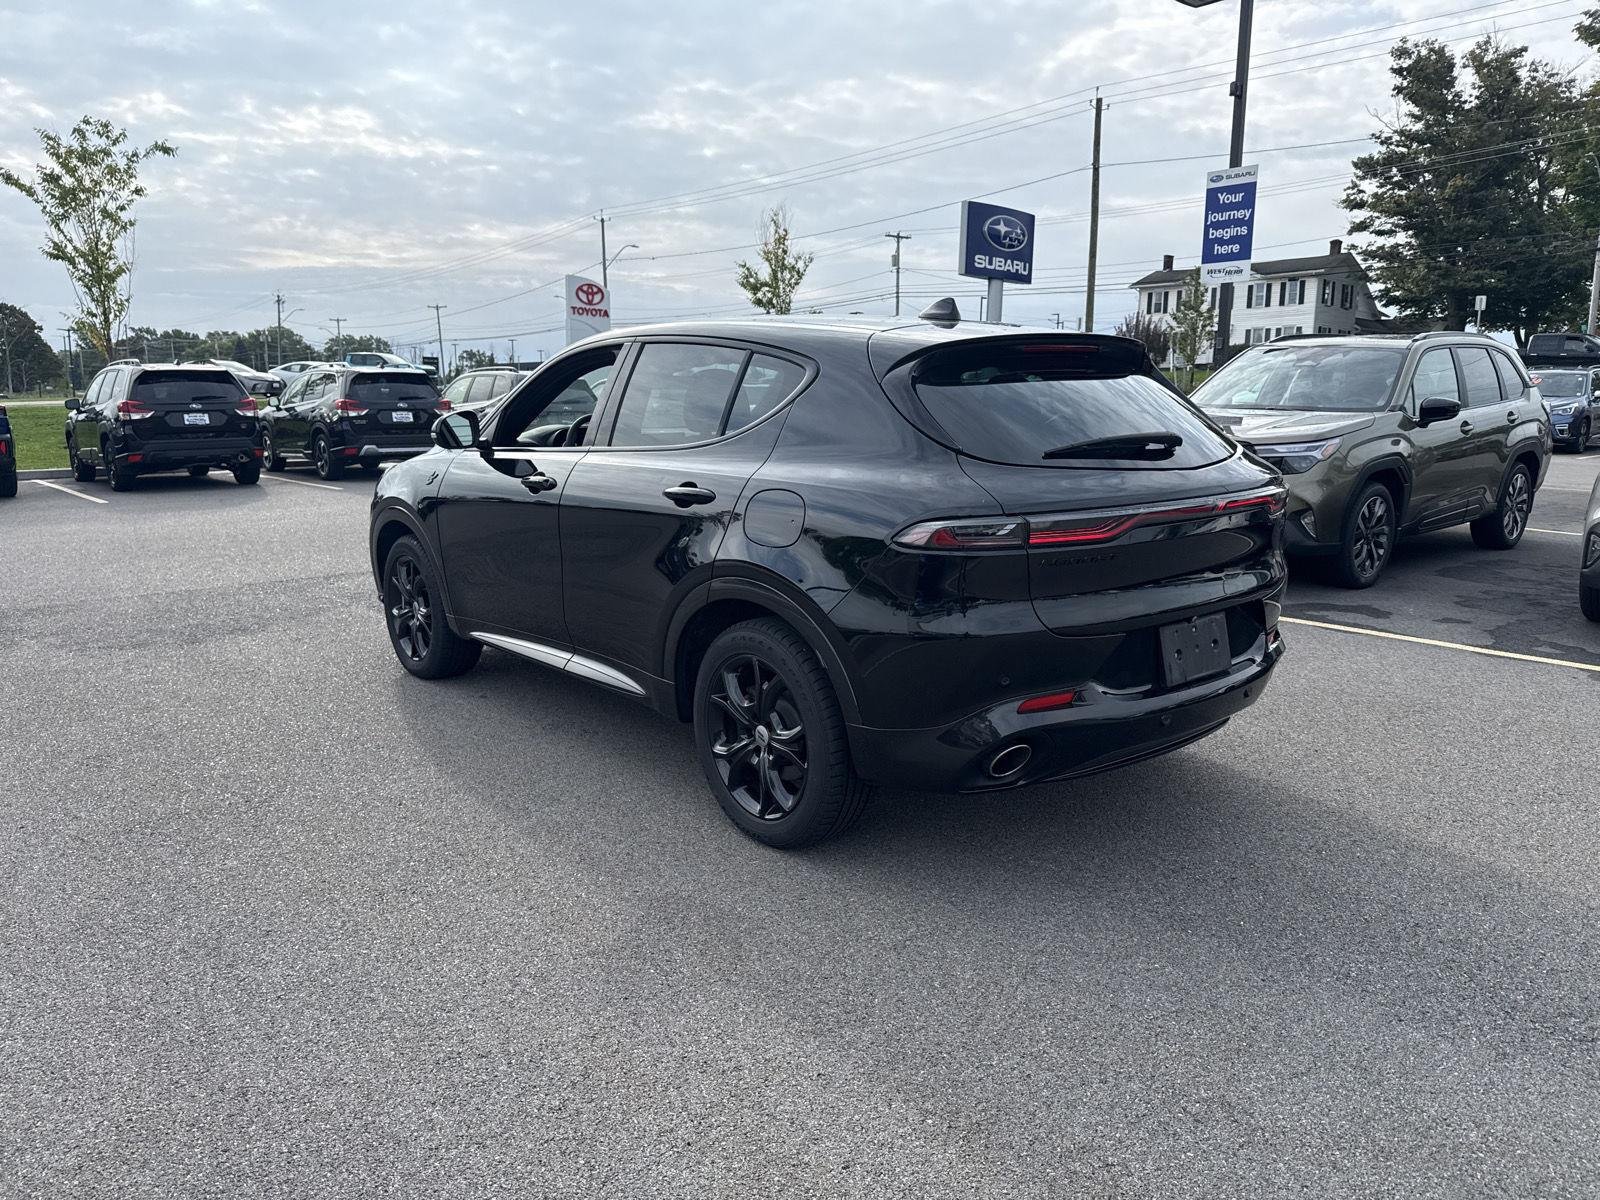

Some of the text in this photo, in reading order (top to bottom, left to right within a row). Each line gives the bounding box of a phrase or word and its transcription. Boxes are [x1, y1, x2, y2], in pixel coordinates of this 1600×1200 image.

[1225, 171, 1256, 180] SUBARU
[1217, 192, 1245, 204] Your
[1207, 208, 1252, 225] journey
[1209, 225, 1248, 240] begins
[1214, 243, 1240, 255] here
[974, 254, 1029, 275] SUBARU
[570, 306, 609, 318] TOYOTA
